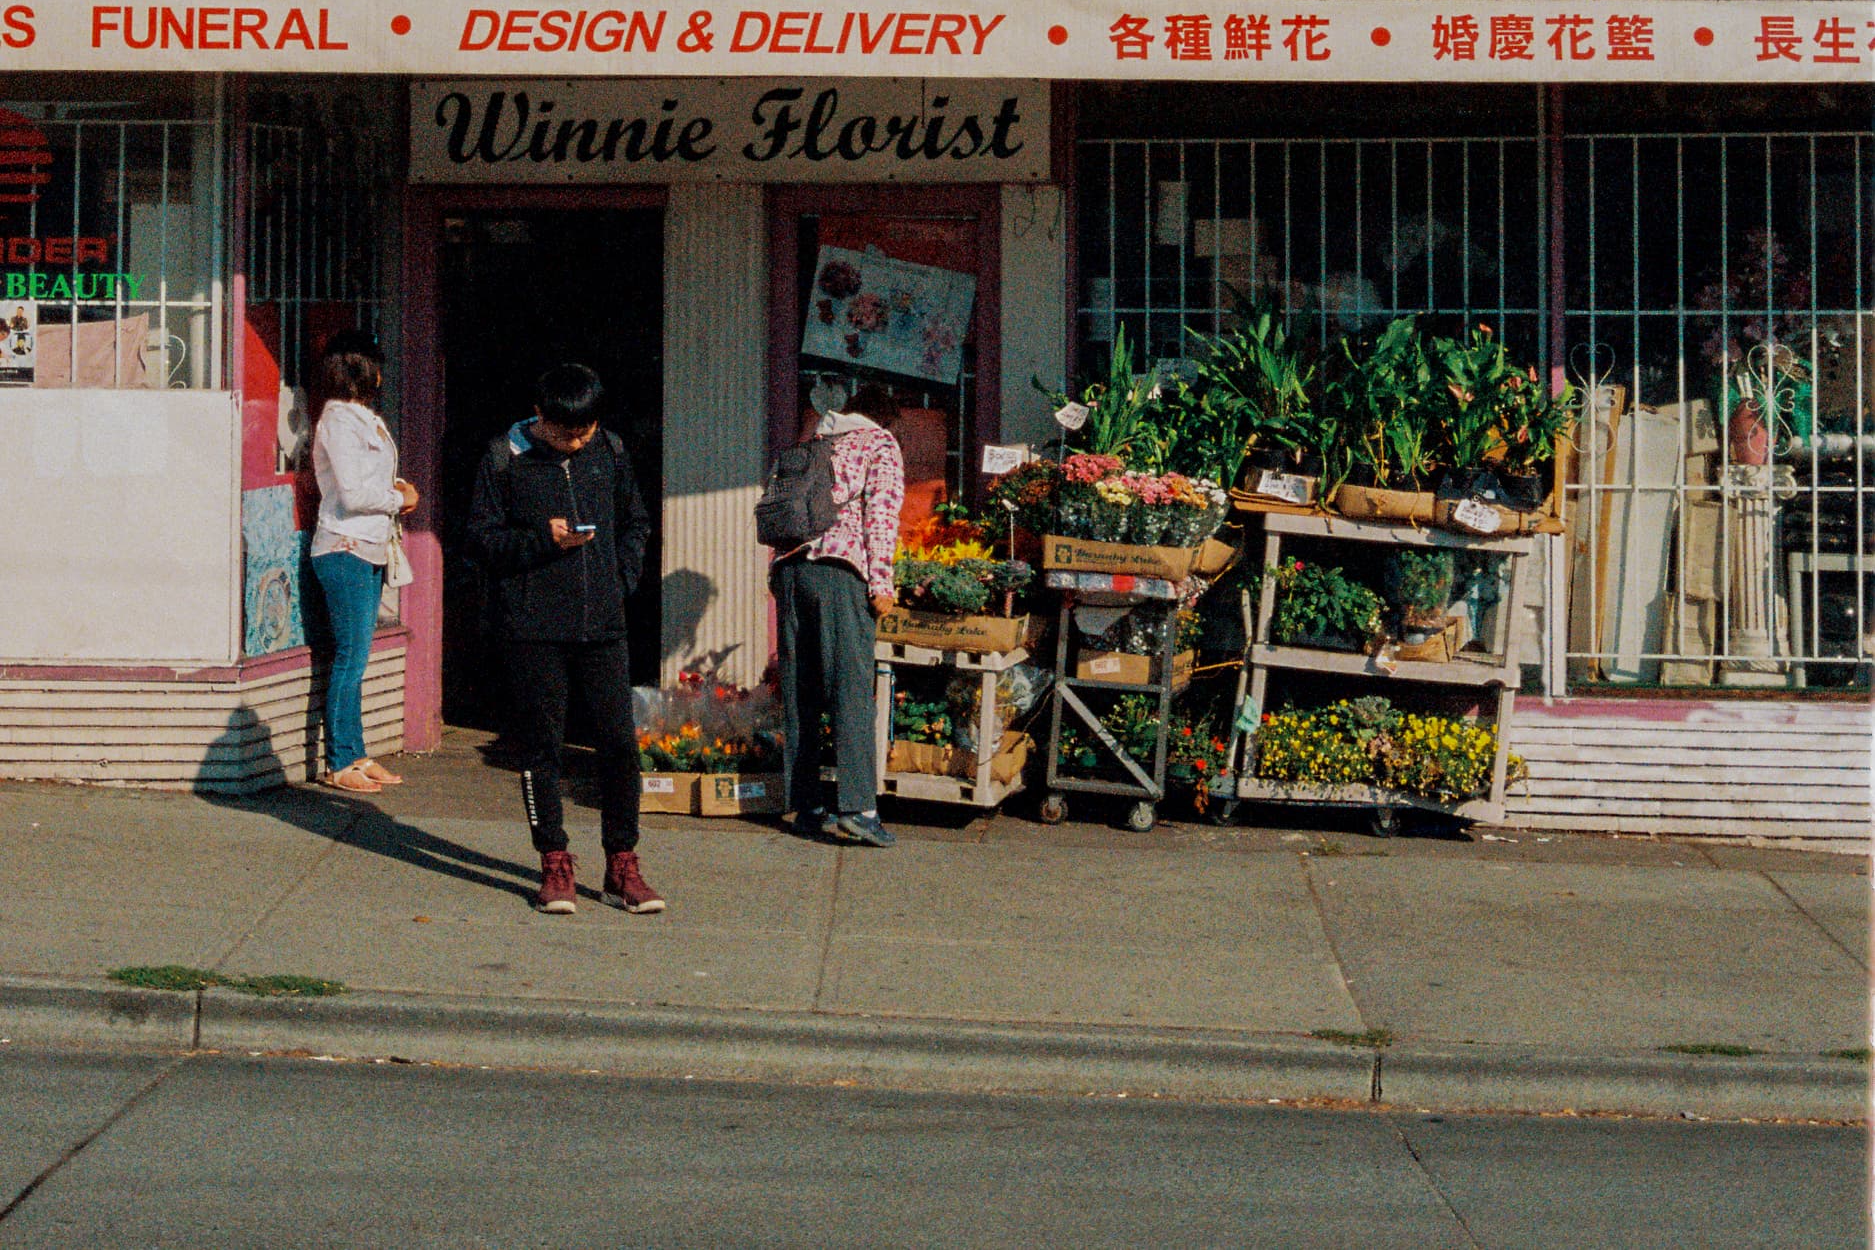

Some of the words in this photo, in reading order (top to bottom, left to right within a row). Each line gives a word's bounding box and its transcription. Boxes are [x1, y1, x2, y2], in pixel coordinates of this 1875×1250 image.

[0, 4, 36, 49] S
[91, 5, 349, 51] FUNERAL
[459, 9, 668, 53] DESIGN
[676, 10, 714, 54] &
[729, 10, 1006, 56] DELIVERY
[1109, 13, 1331, 62] 各種鮮花
[1431, 13, 1655, 61] 婚慶花籃
[1754, 16, 1874, 64] 長生
[435, 91, 717, 163] Winnie
[742, 88, 1024, 161] Florist
[0, 237, 108, 264] DER
[6, 272, 145, 299] BEAUTY
